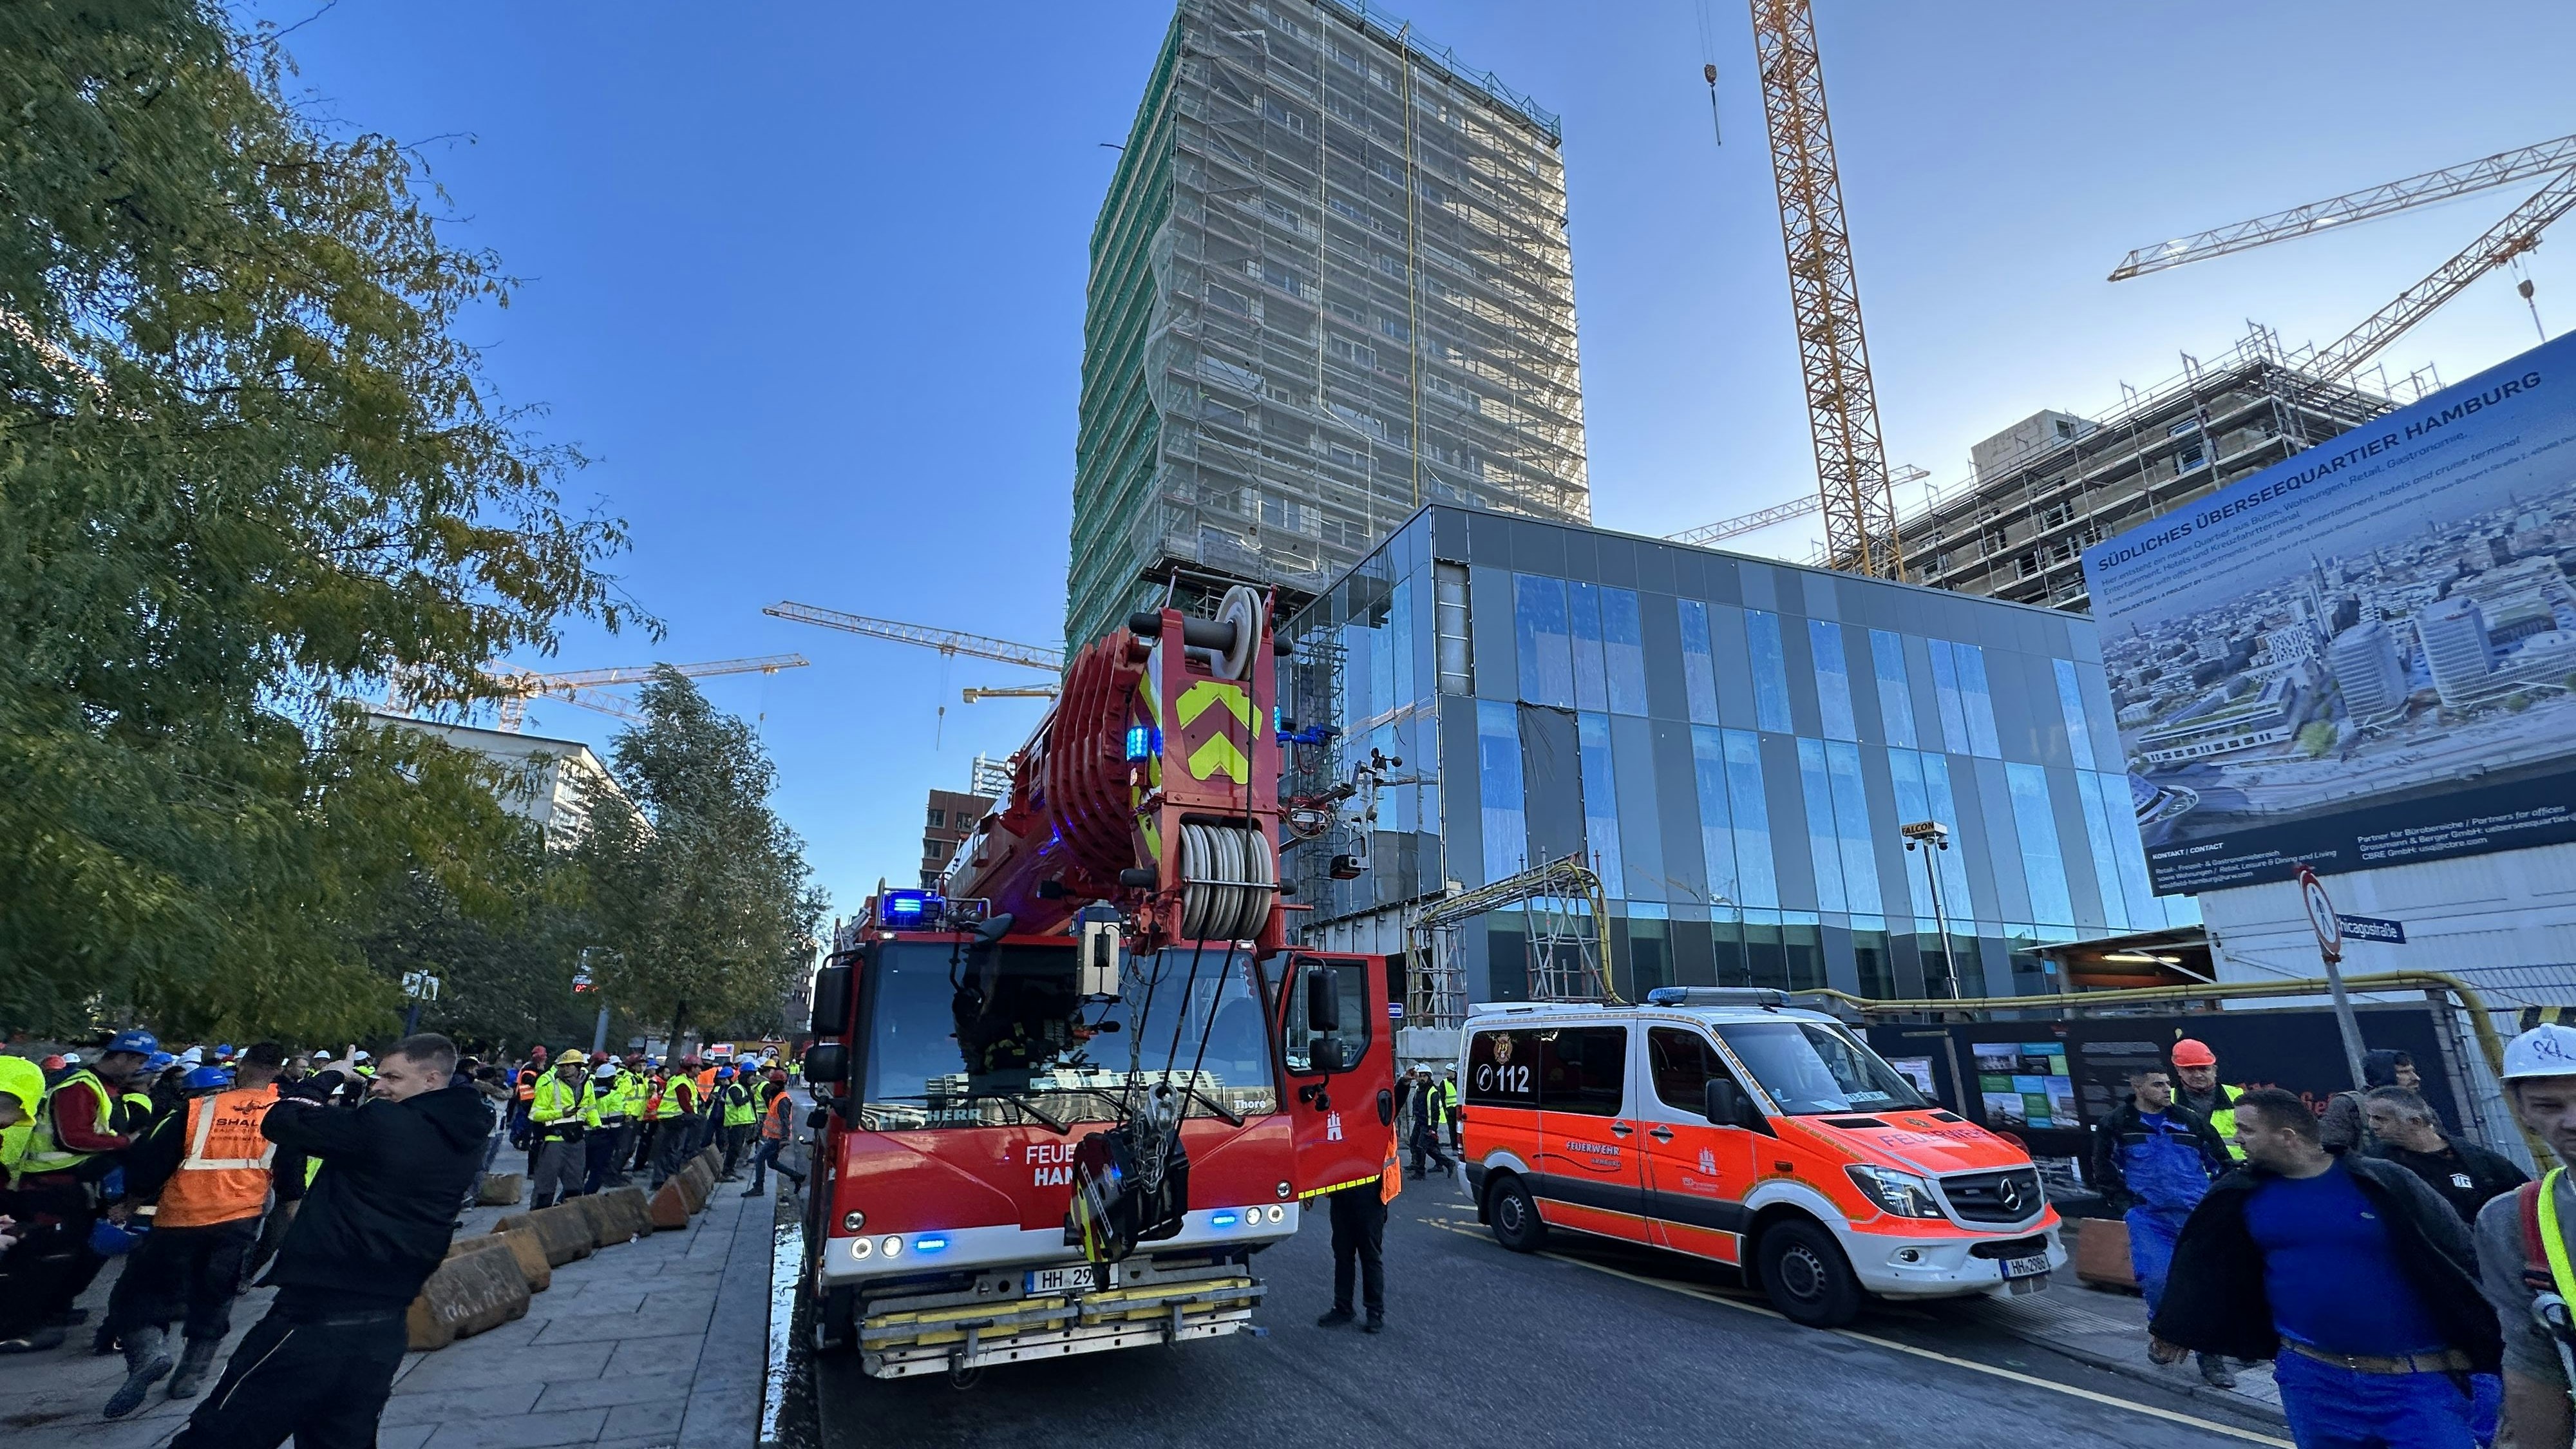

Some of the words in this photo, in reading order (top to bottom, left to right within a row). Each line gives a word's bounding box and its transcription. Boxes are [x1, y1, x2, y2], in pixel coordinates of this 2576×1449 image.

[2098, 522, 2192, 572] SÜDLICHES
[2196, 433, 2400, 529] ÜBERSEEQUARTIER
[2405, 372, 2541, 440] HAMBURG
[2101, 577, 2118, 587] Hier
[2119, 562, 2152, 580] entsteht
[2154, 556, 2165, 565] ein
[2168, 546, 2192, 559] neues
[2194, 529, 2231, 549] Quartier
[2233, 522, 2249, 531] aus
[2251, 508, 2282, 525] Büros,
[2284, 482, 2348, 511] Wohnungen,
[2387, 432, 2468, 469] Gastronomie,
[2113, 593, 2127, 603] new
[2128, 583, 2154, 600] quarter
[2156, 576, 2172, 587] with
[2380, 479, 2410, 498] hotels
[2413, 471, 2433, 485] and
[2435, 458, 2469, 477] cruise
[2471, 435, 2521, 461] terminal
[2104, 569, 2162, 596] Entertainment,
[2163, 556, 2191, 572] Hotels
[2193, 548, 2209, 560] und
[2210, 511, 2301, 554] Kreuzfahrtterminal
[2119, 601, 2145, 614] PROJEKT
[2166, 582, 2193, 596] PROJECT
[1902, 821, 1934, 836] FALCON
[2358, 833, 2389, 844] Partner
[2391, 829, 2403, 838] für
[2404, 820, 2464, 836] Bürobereiche
[2472, 813, 2514, 826] Partners
[2515, 810, 2530, 820] for
[2532, 805, 2566, 817] offices
[2360, 838, 2408, 852] Grossmann
[2419, 833, 2450, 845] Berger
[2451, 827, 2484, 838] GmbH:
[2485, 810, 2576, 833] ueberseequartier@
[2152, 848, 2184, 860] KONTAKT
[2190, 842, 2224, 854] CONTACT
[2212, 850, 2280, 866] Gastronomiebereich
[2362, 851, 2386, 860] CBRE
[2176, 867, 2213, 881] Wohnungen
[2241, 860, 2267, 870] Leisure
[2275, 855, 2298, 866] Dining
[2298, 852, 2313, 861] and
[2315, 848, 2337, 860] Living
[1497, 1065, 1529, 1092] 112
[1234, 1099, 1266, 1109] Thore
[216, 1118, 258, 1126] SHAL
[878, 1108, 982, 1123] LIEHERR
[1877, 1128, 1993, 1147] FEUERWEHR
[1026, 1144, 1076, 1164] FEUE
[1566, 1141, 1620, 1155] FEUERWEHR
[2011, 1260, 2025, 1274] HH
[1043, 1271, 1063, 1289] HH
[1074, 1268, 1095, 1285] 29
